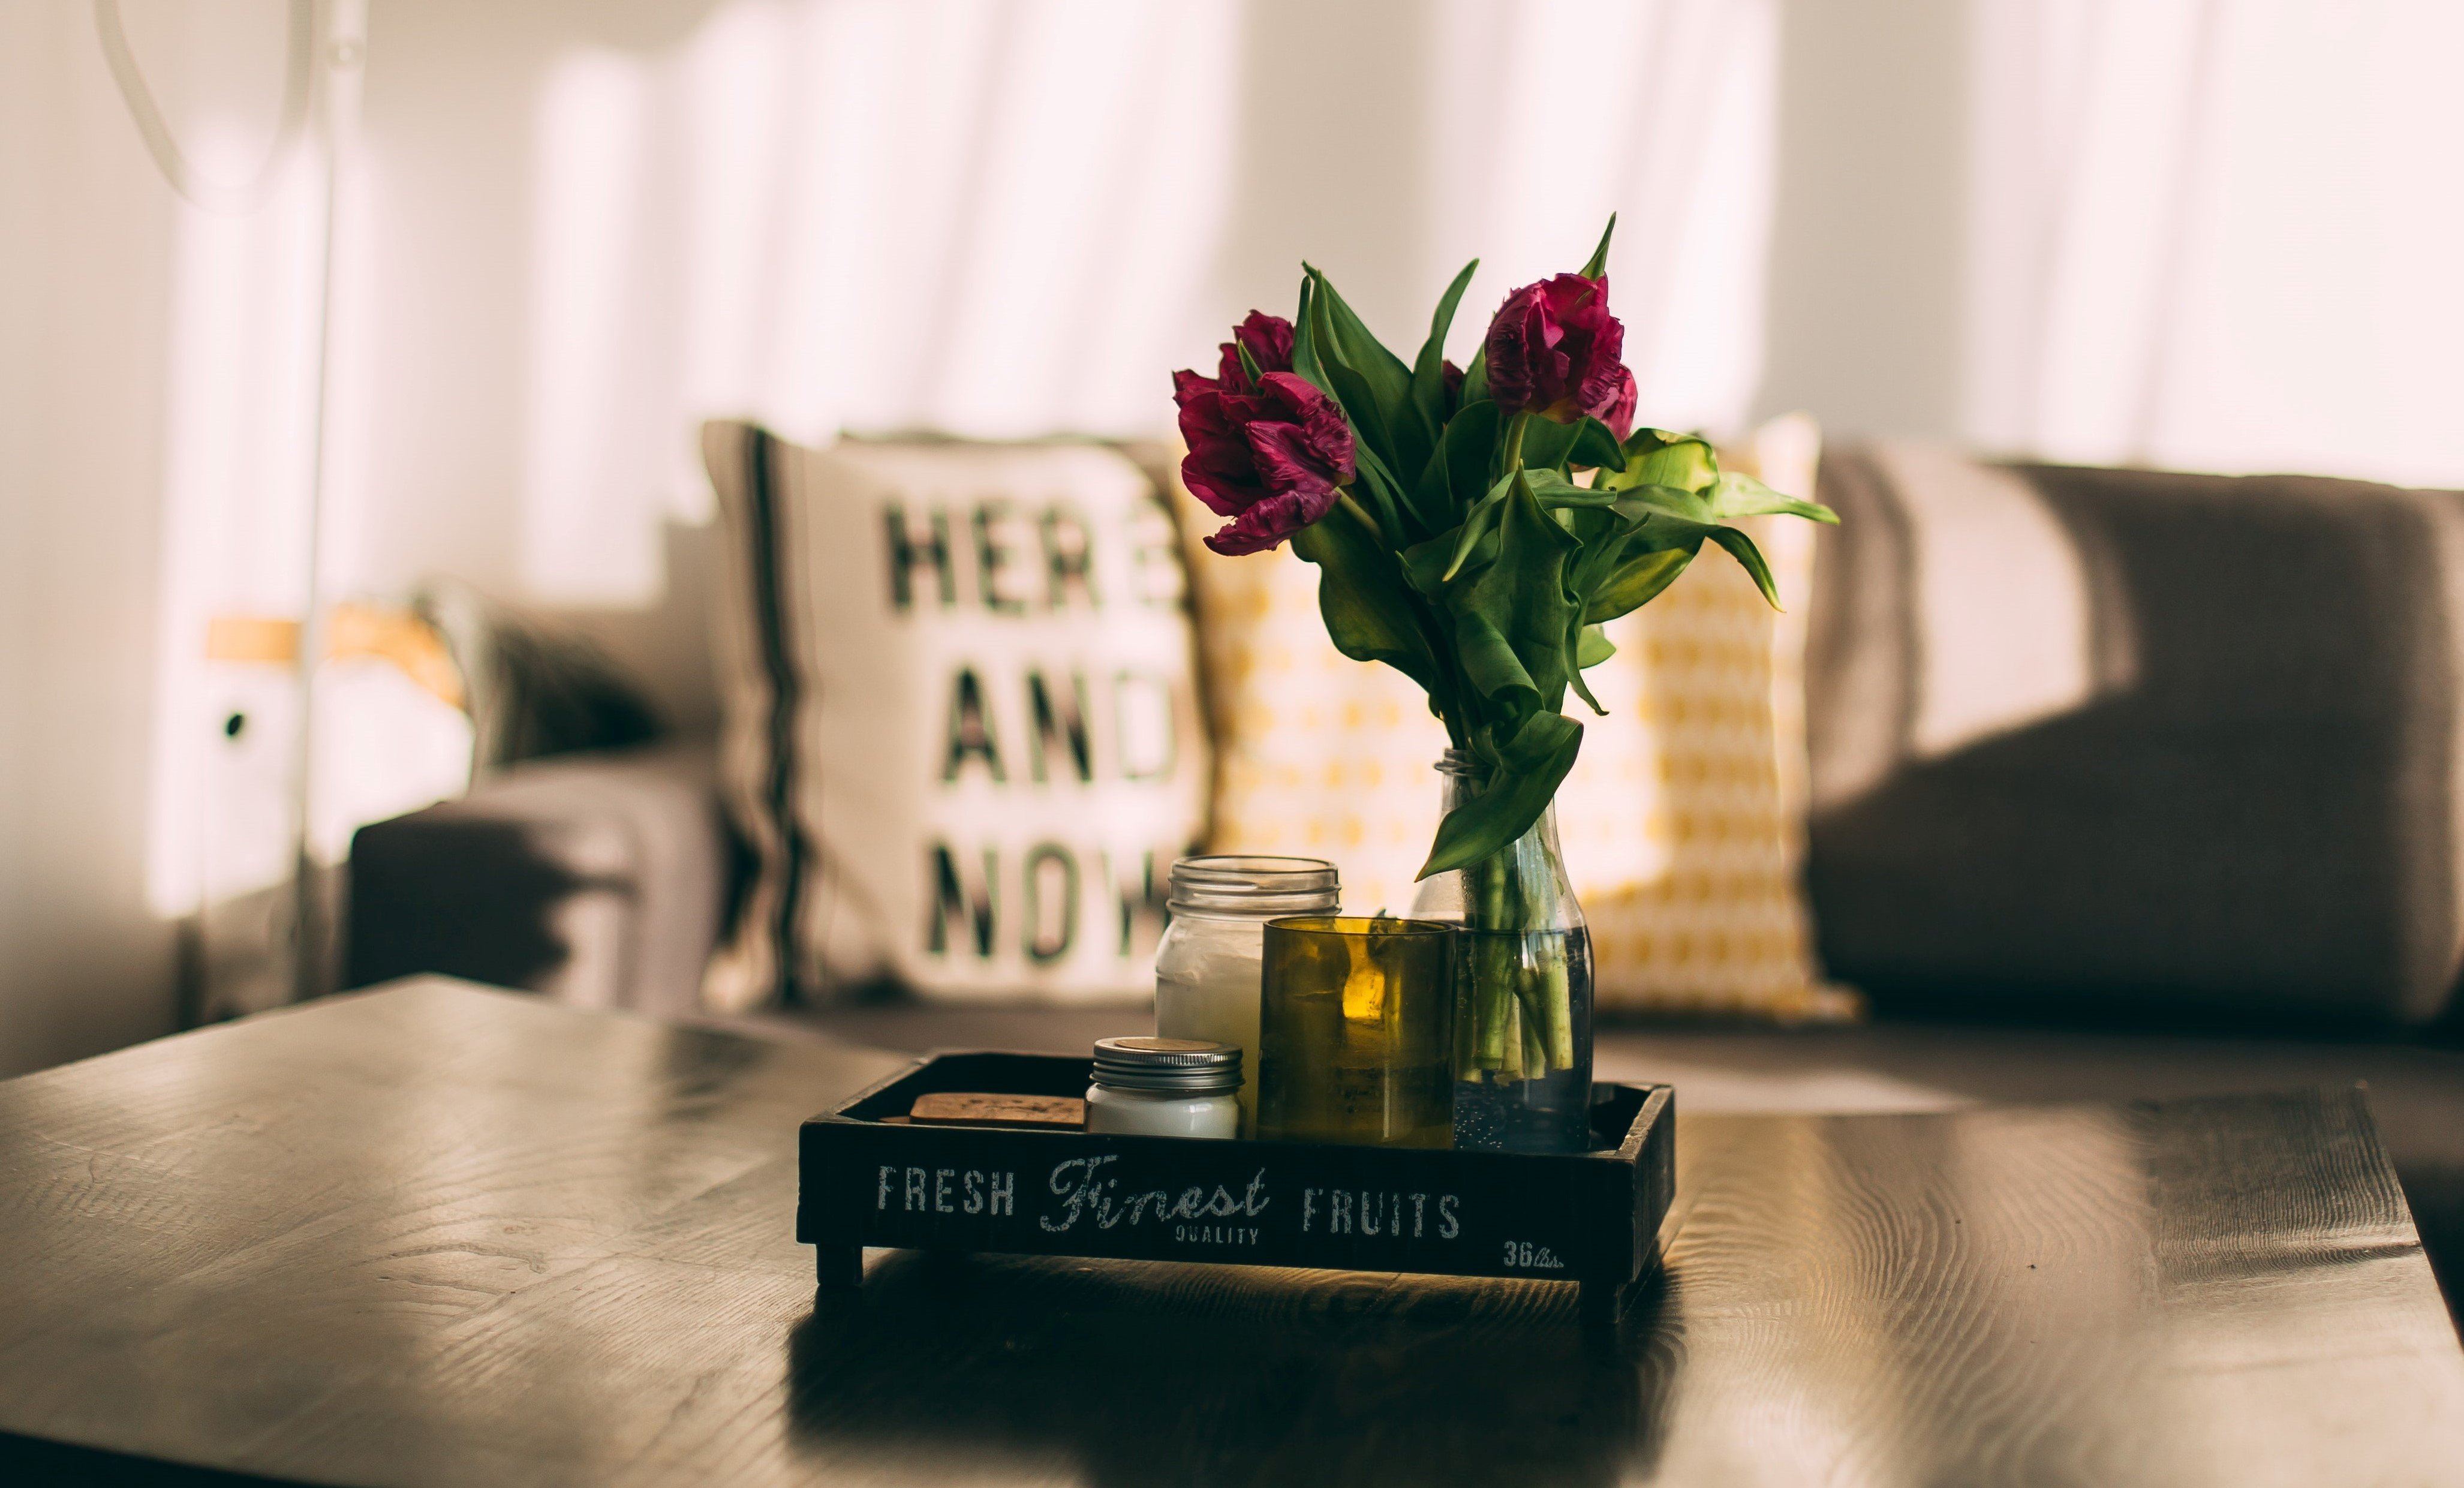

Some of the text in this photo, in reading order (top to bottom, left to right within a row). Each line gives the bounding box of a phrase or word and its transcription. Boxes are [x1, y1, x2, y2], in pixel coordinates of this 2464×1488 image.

[884, 503, 1184, 609] HERE
[941, 666, 1177, 783] AND
[878, 1154, 1460, 1239] FRESH Finest FRUITS
[1175, 1224, 1259, 1246] QUALITY
